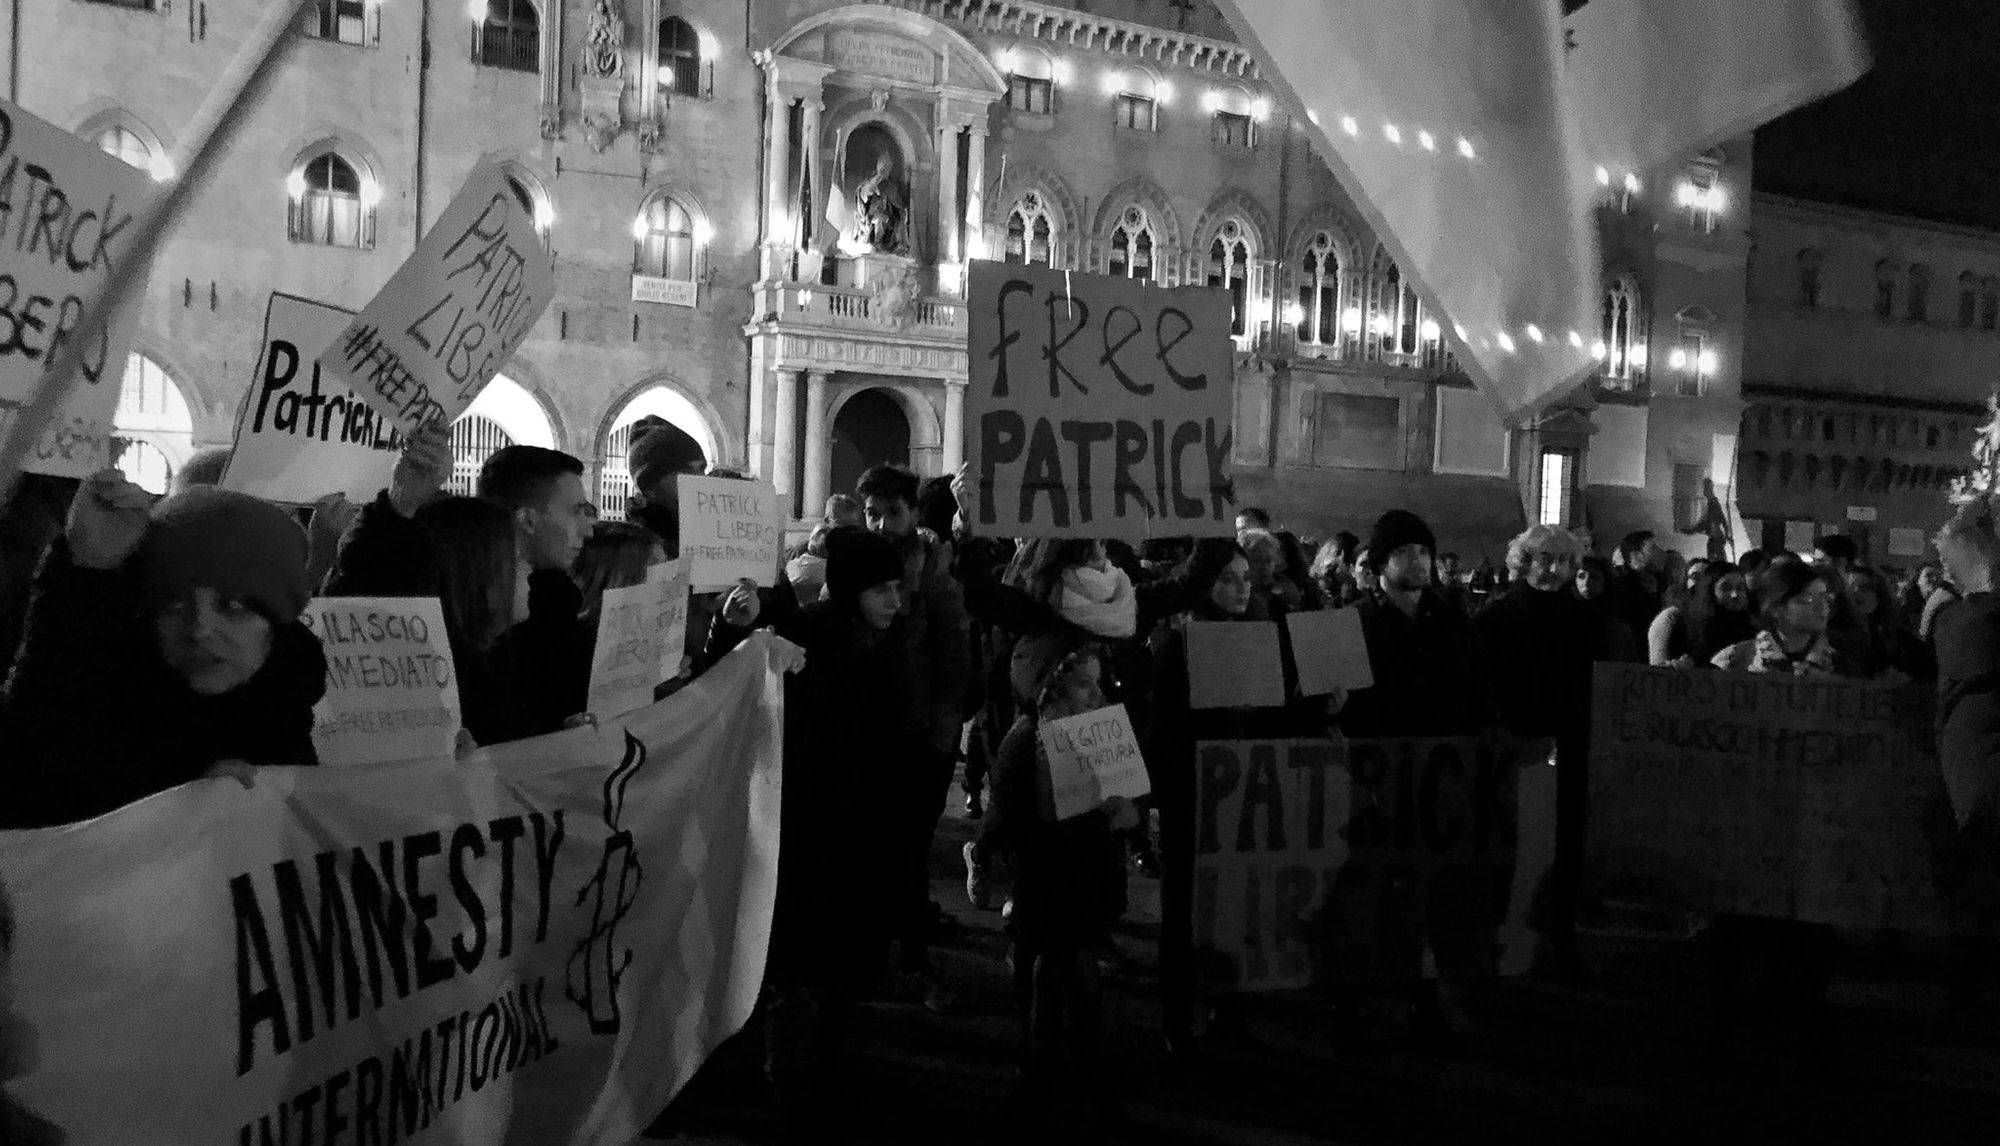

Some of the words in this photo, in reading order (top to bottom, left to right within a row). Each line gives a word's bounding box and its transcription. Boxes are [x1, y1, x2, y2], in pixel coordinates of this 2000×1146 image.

[697, 491, 762, 517] PATRICK
[978, 410, 1238, 528] PATRICK
[717, 520, 774, 545] LIBERO
[1198, 742, 1519, 853] PATRICK
[229, 809, 565, 1078] AMNESTY
